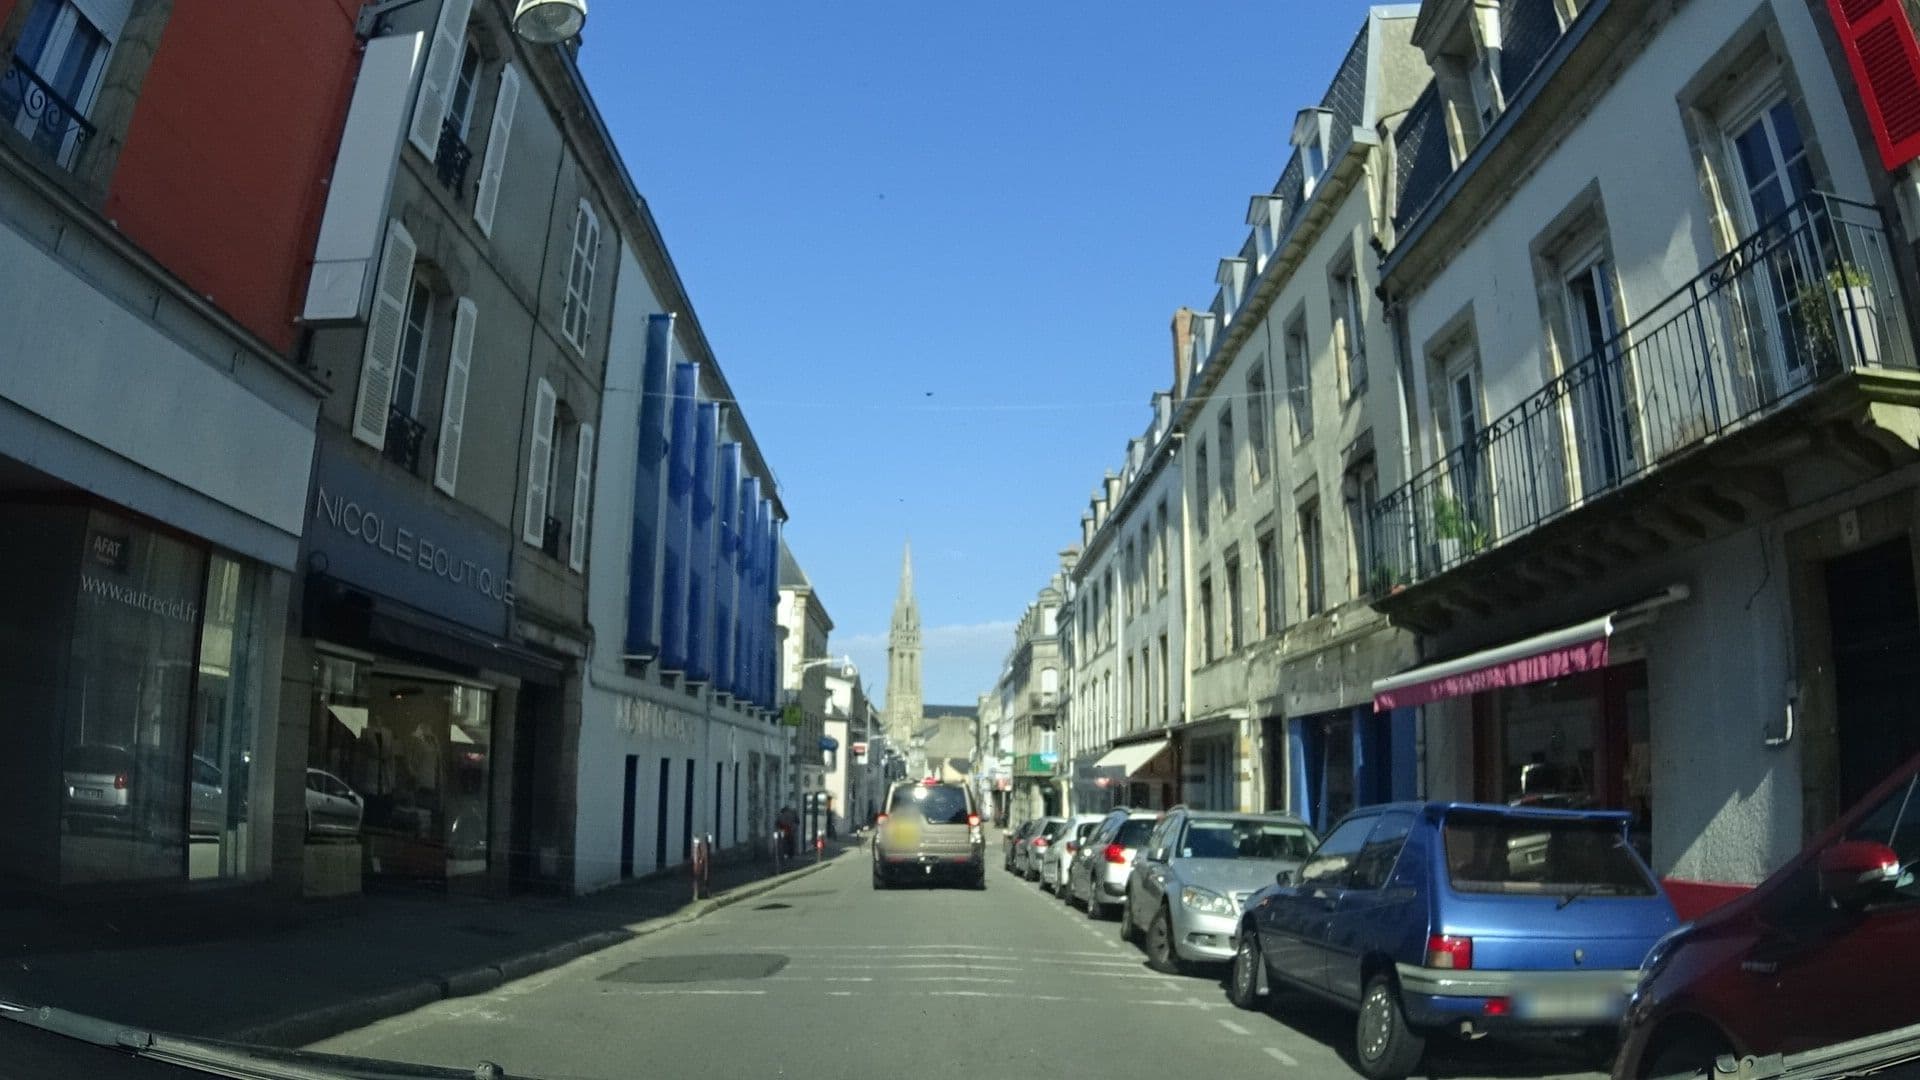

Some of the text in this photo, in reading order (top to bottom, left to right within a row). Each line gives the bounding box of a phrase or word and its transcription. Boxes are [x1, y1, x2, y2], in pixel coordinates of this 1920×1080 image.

[94, 536, 120, 557] AFAT
[316, 486, 515, 606] NICOLE BOUTIQUE
[82, 575, 198, 623] www.autreciel.fr
